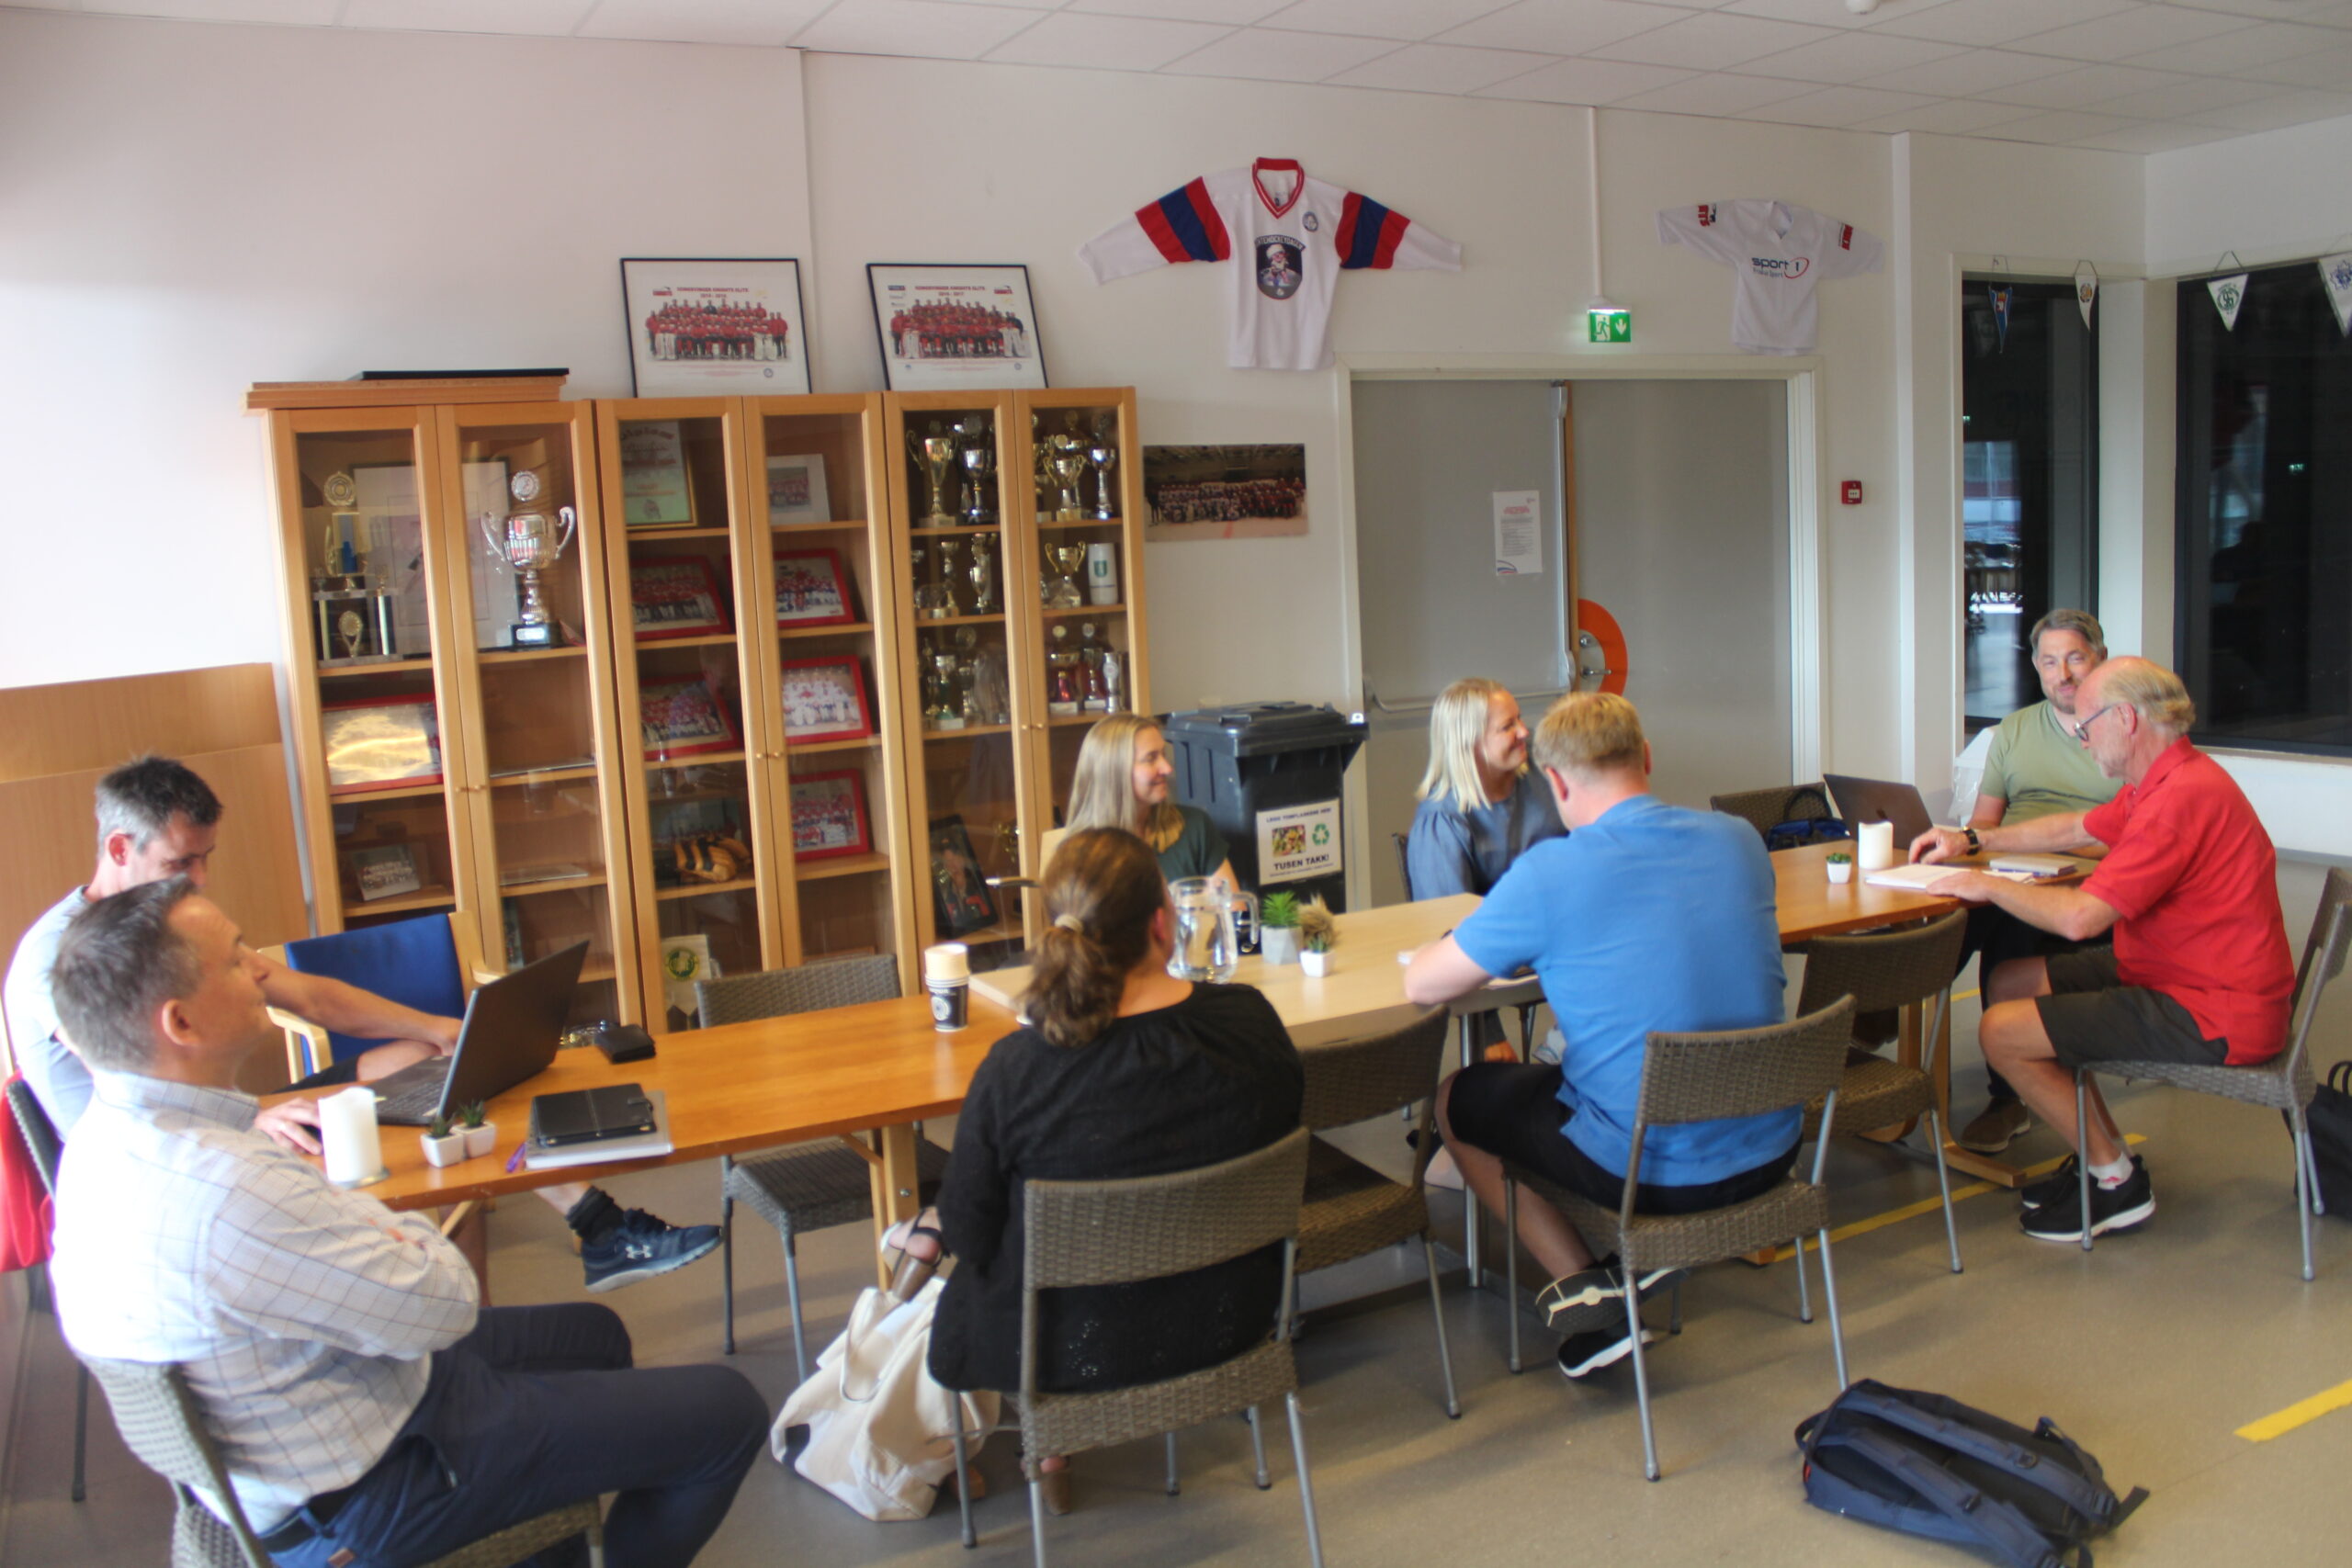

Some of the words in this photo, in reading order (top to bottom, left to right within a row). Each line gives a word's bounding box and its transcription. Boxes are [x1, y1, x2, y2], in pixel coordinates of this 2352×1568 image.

[1751, 257, 1790, 270] sport
[1274, 860, 1303, 870] TUSEN
[1305, 854, 1329, 864] TAKK!
